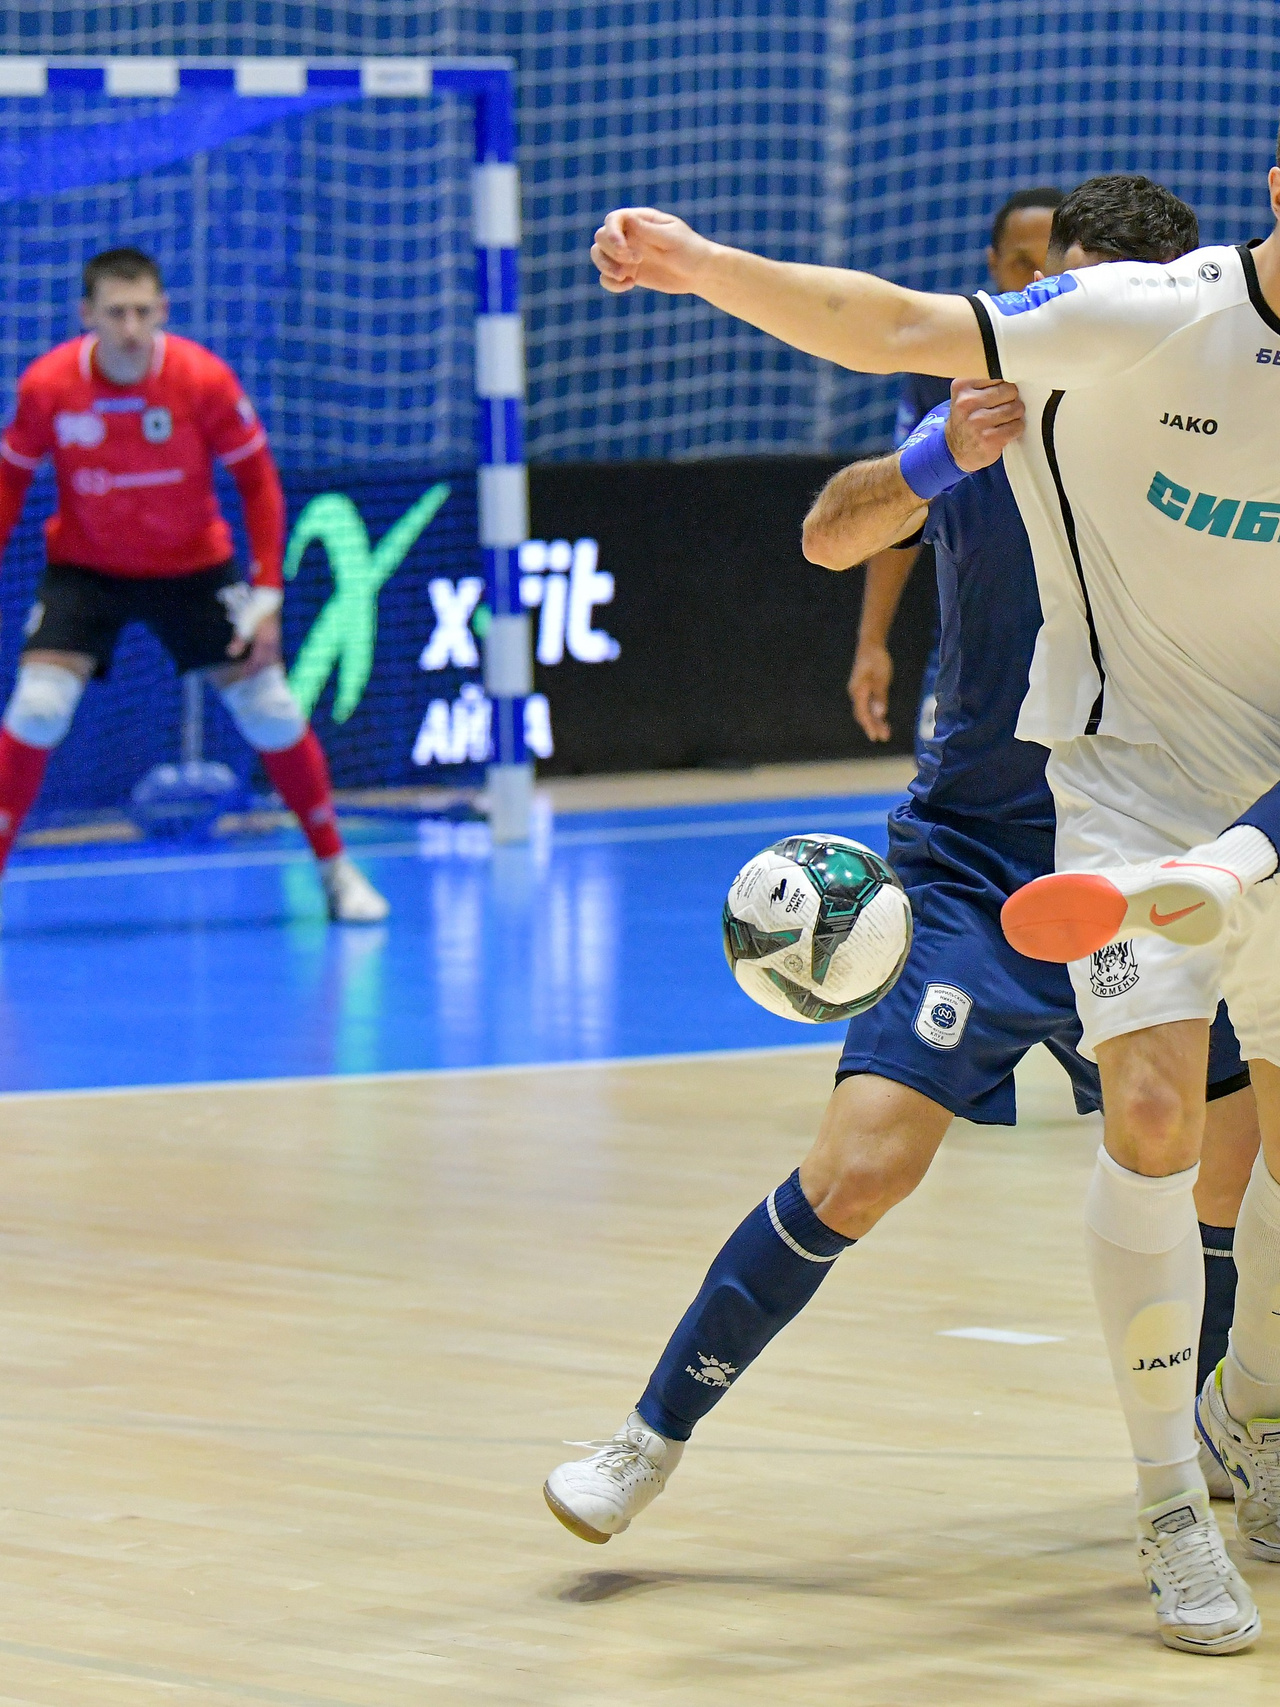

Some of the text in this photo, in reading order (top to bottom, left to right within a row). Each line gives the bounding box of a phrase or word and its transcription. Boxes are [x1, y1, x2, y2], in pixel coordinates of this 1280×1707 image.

[1160, 412, 1218, 435] JAKO
[411, 682, 554, 766] АЙА
[785, 887, 800, 913] СУПЕР
[792, 893, 806, 914] ЛИГА
[1095, 976, 1135, 995] ТЮМЕНЬ
[1132, 1347, 1191, 1371] JAKO
